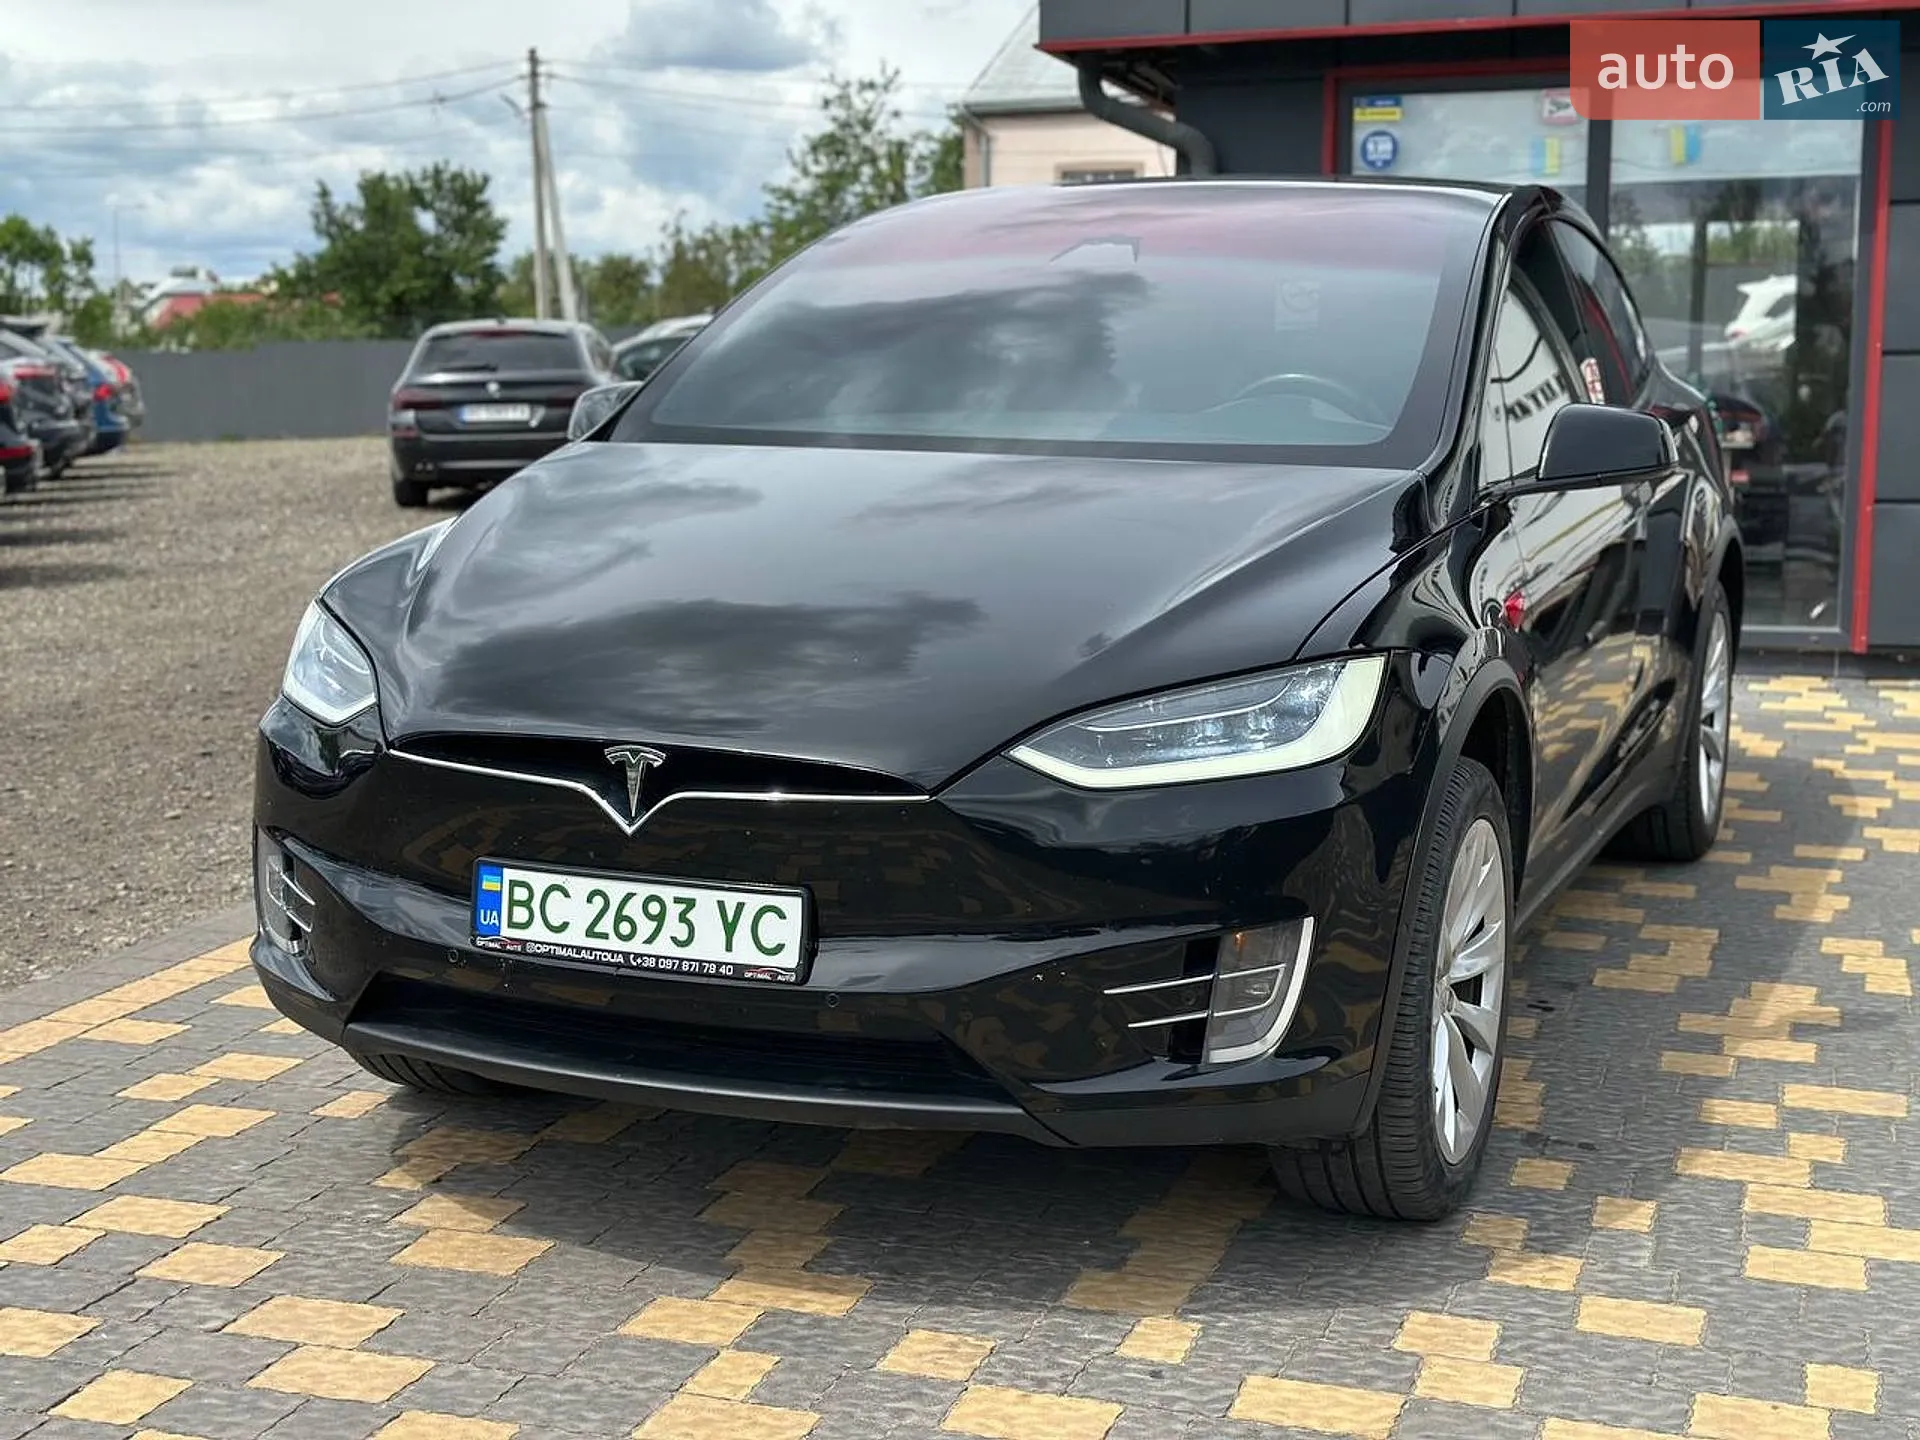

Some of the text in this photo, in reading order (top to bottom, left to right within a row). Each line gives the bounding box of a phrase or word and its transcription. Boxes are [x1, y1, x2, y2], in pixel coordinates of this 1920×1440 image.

[480, 909, 499, 926] UA
[508, 879, 787, 956] BC 2693 YC
[682, 961, 699, 973] 871
[718, 964, 734, 975] 40
